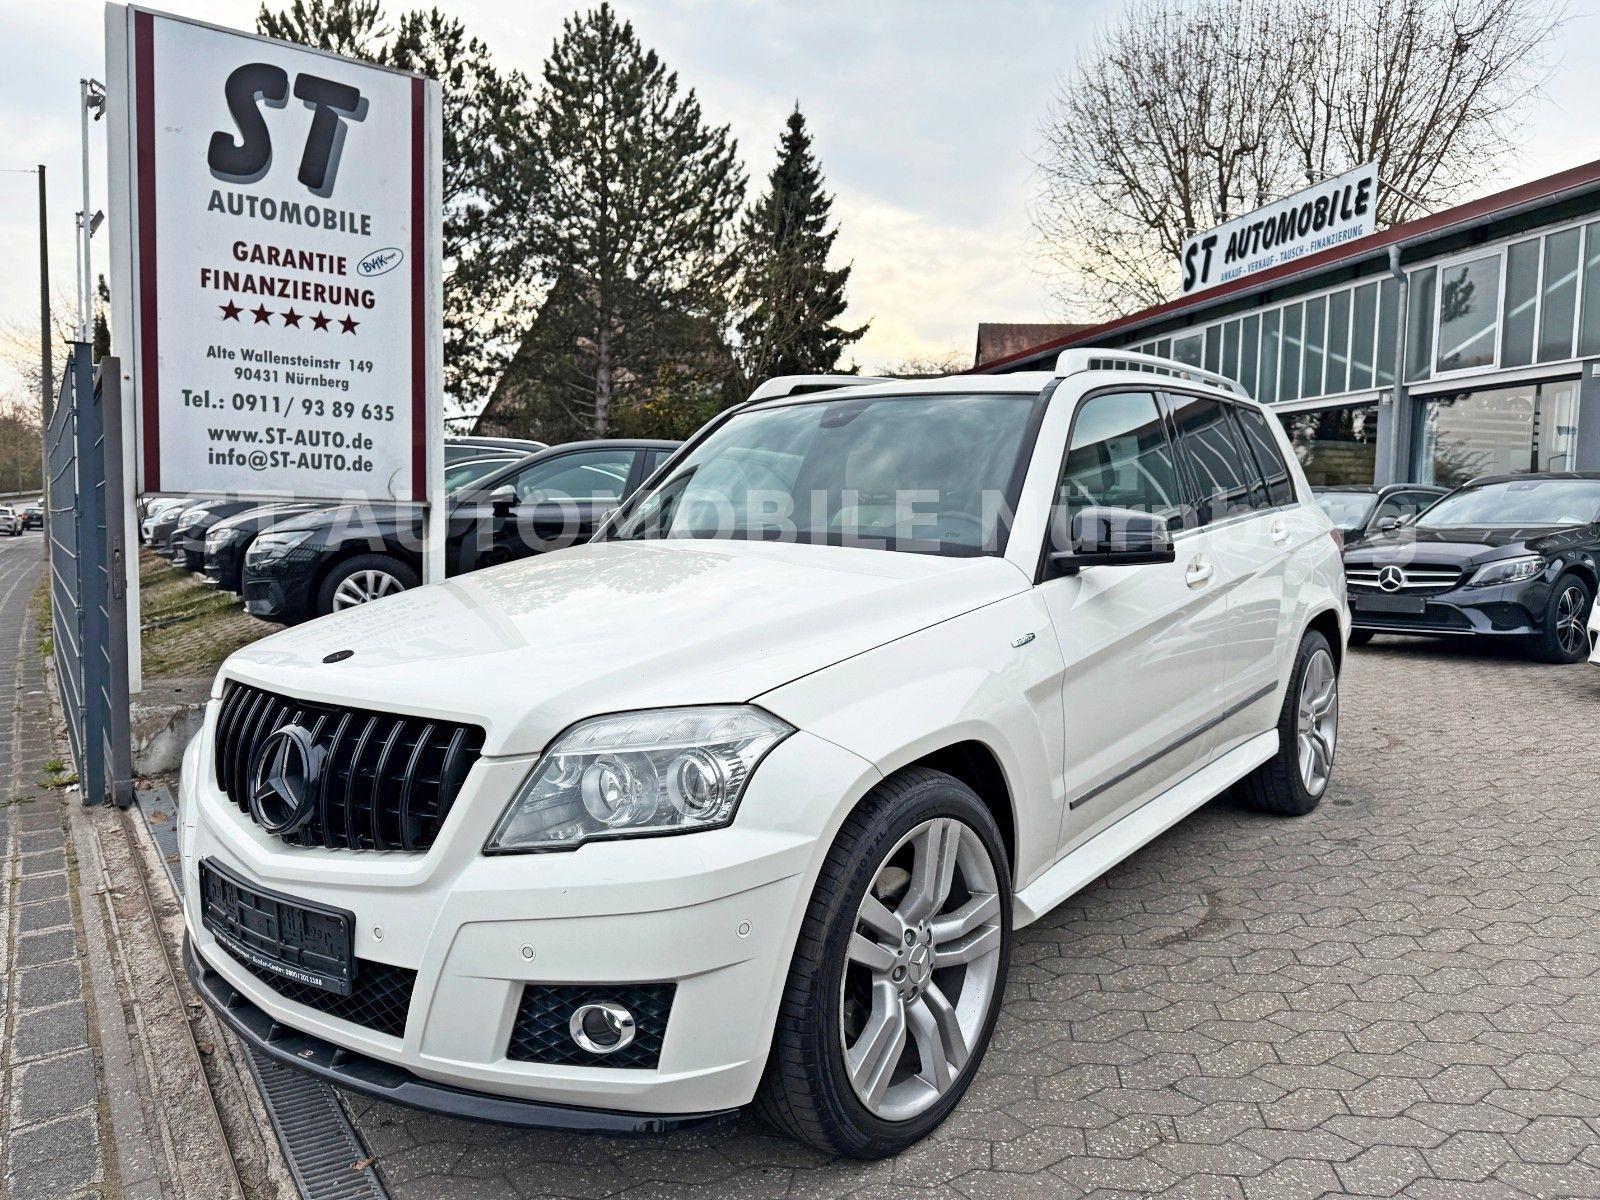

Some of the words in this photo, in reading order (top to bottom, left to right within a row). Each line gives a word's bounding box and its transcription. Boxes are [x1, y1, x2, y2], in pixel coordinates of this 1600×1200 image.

[207, 62, 370, 199] ST
[207, 189, 371, 236] AUTOMOBILE
[1183, 234, 1218, 292] ST
[1224, 176, 1372, 265] AUTOMOBILE
[1248, 255, 1274, 273] VERKAUF
[1280, 245, 1304, 262] TAUSCH
[1310, 224, 1363, 252] FINANZIERUNG
[232, 240, 347, 276] GARANTIE
[200, 267, 376, 310] FINANZIERUNG
[206, 345, 236, 360] Alte
[240, 348, 341, 370] Wallensteinstr
[349, 358, 374, 374] 149
[233, 366, 279, 384] 90431
[285, 371, 350, 392] Nürnberg
[181, 389, 225, 410] Tel.:
[301, 398, 325, 417] 93
[332, 400, 355, 420] 89
[361, 402, 395, 422] 635
[207, 427, 374, 451] www.ST-AUTO.de
[207, 447, 374, 472] info@ST-AUTO.de
